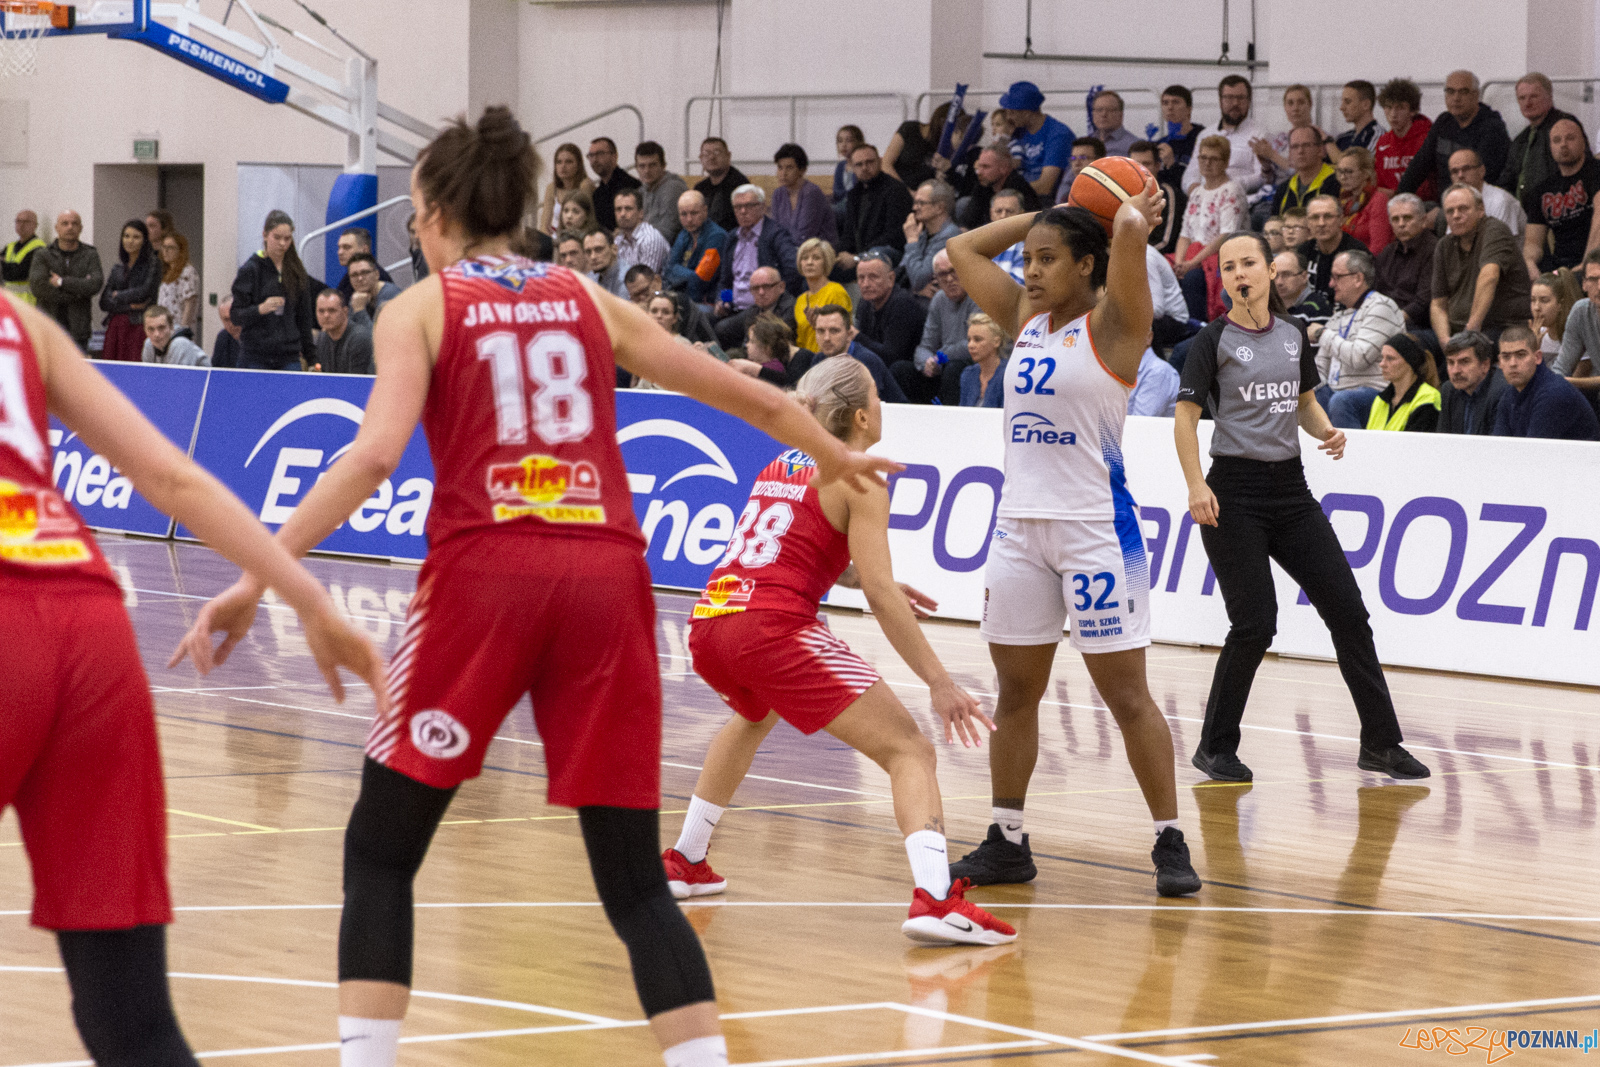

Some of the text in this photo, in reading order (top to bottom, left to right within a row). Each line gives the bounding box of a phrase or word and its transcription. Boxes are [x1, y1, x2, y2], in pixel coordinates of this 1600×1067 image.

[168, 32, 266, 88] PESMENPOL
[475, 330, 594, 445] 18
[1015, 357, 1056, 395] 32
[1238, 381, 1300, 402] VERON
[1011, 424, 1076, 445] Enea
[51, 429, 134, 509] nea
[779, 449, 816, 466] Lazu
[259, 447, 434, 537] Eea
[715, 499, 795, 569] 88
[1072, 572, 1119, 611] 32
[1099, 616, 1121, 626] SZKÓŁ
